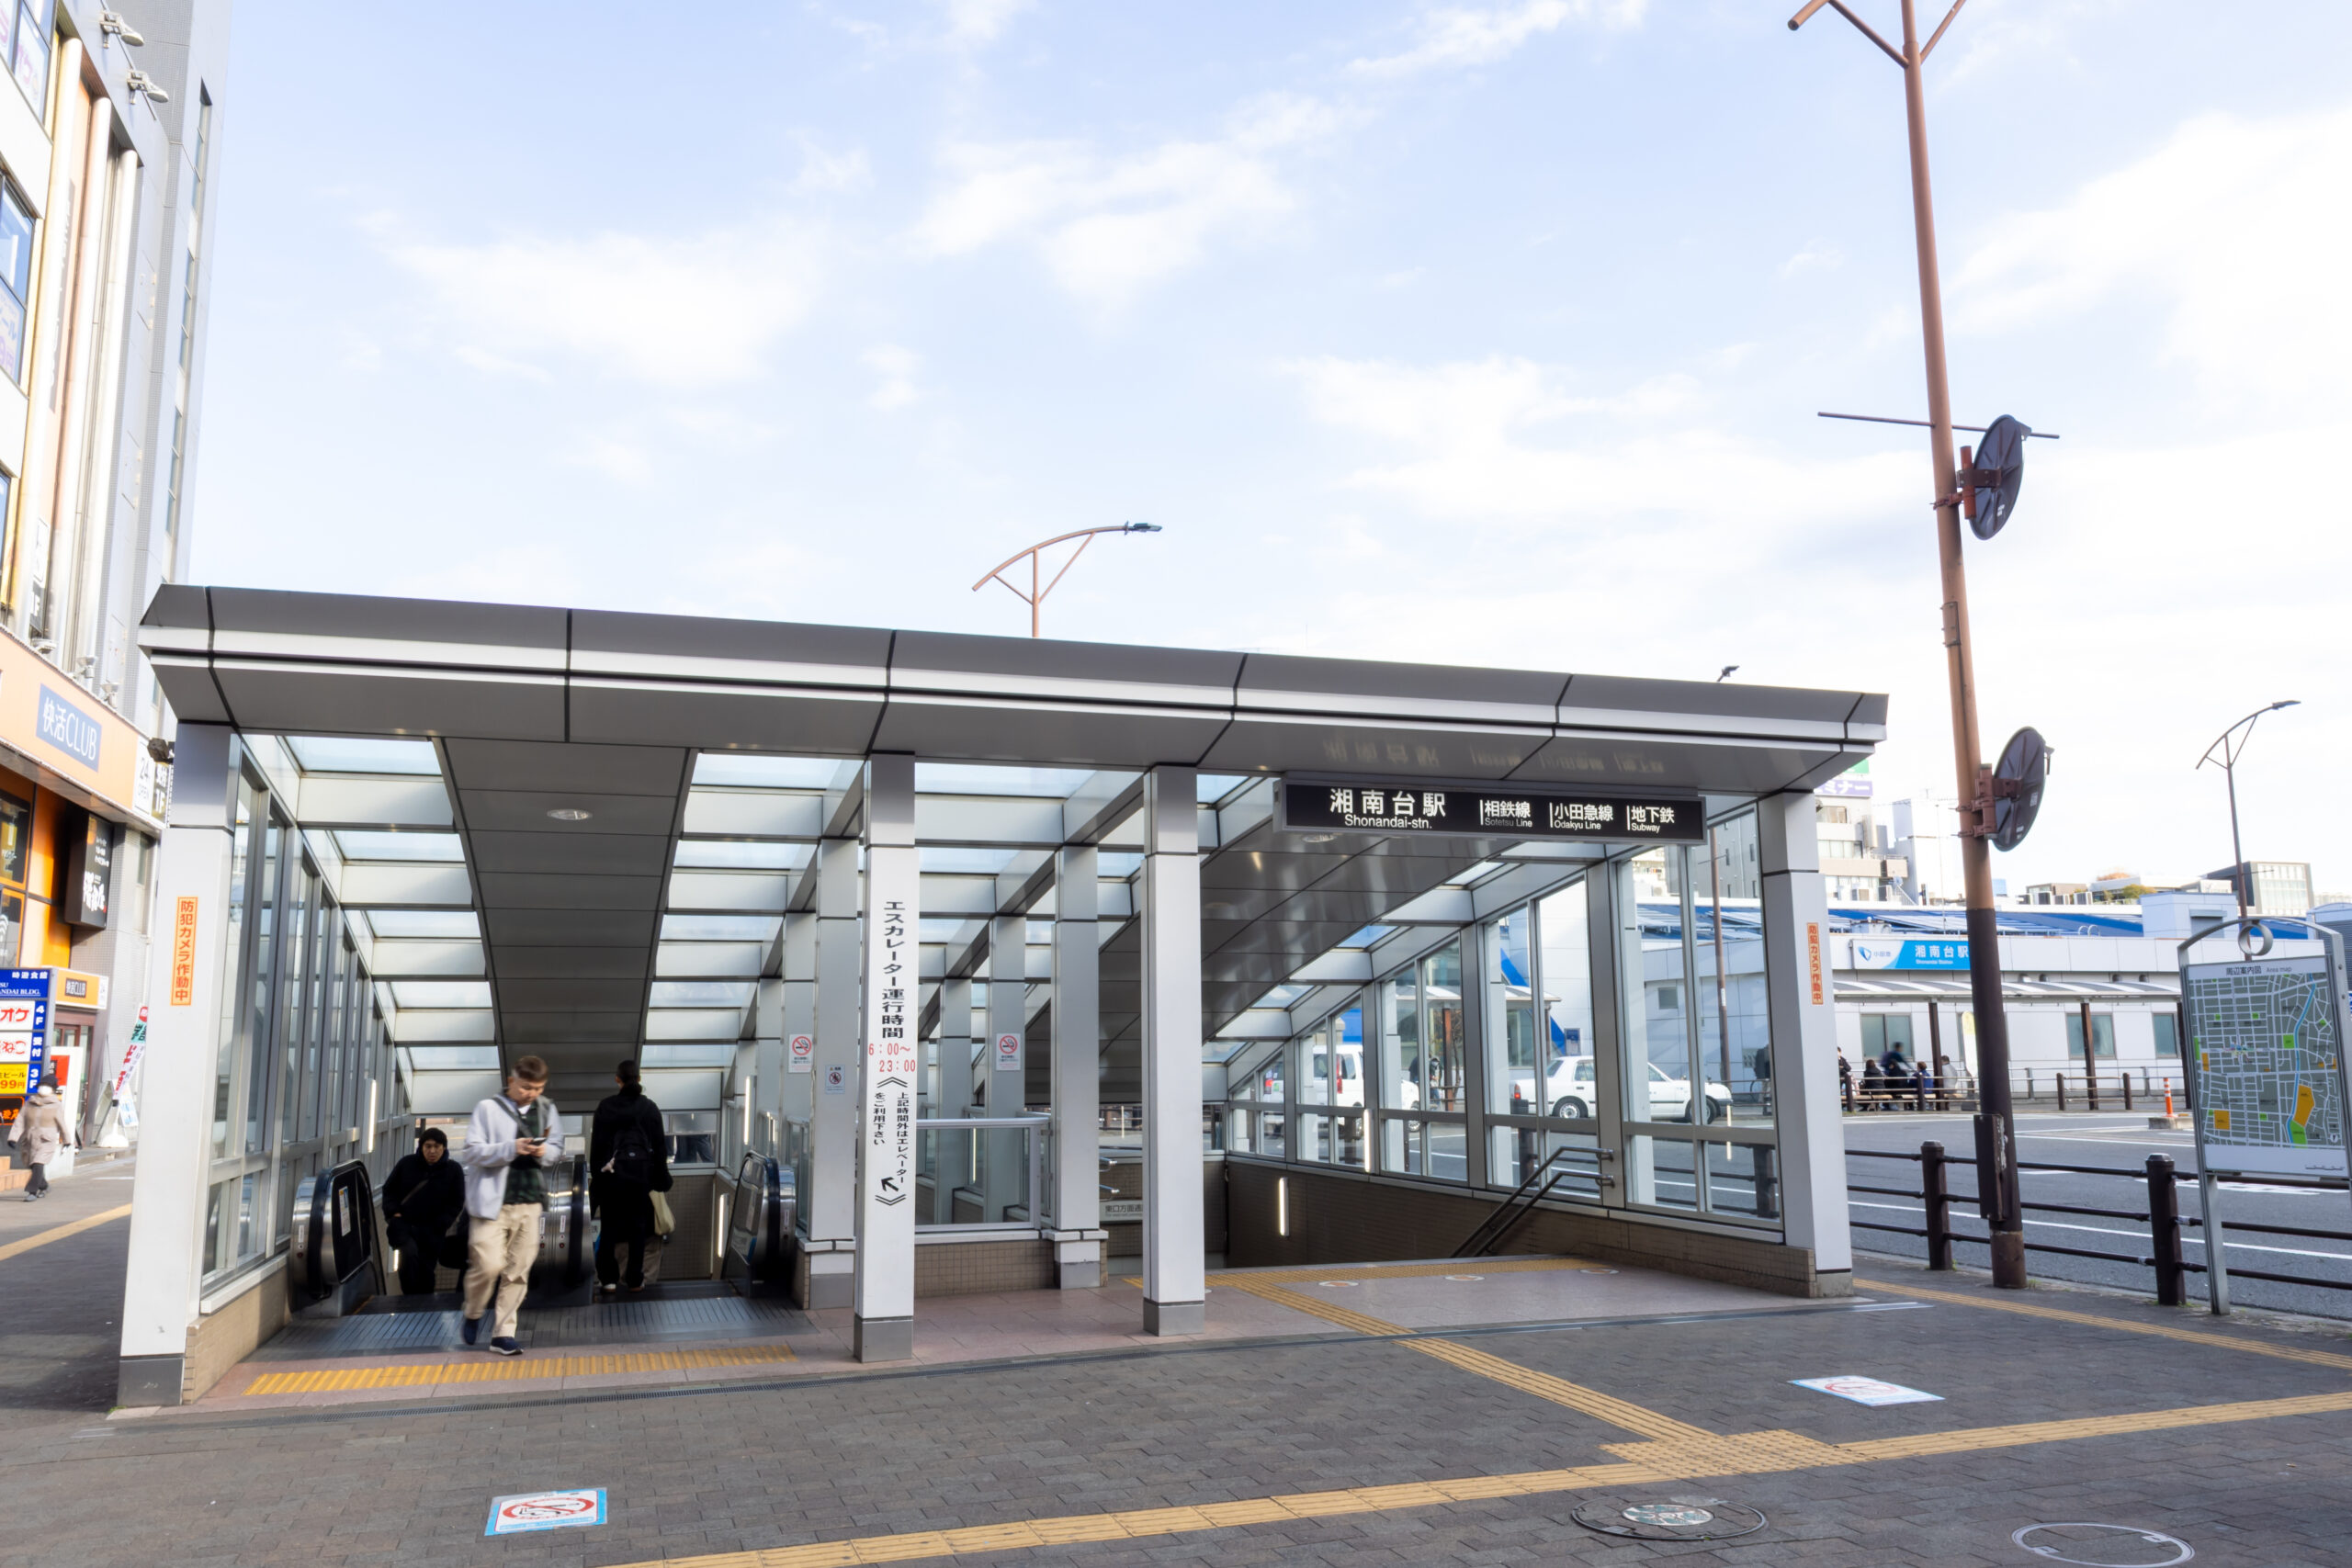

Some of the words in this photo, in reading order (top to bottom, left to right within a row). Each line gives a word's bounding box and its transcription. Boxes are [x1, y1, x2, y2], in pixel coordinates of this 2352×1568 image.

[43, 696, 96, 761] 快活CLUB
[1330, 788, 1446, 818] 湘南台駅
[1485, 800, 1531, 818] 相鉄線
[1344, 814, 1432, 829] Shonandai-stn.
[1555, 803, 1613, 822] 小田急線
[1632, 806, 1675, 824] 地下鉄
[1485, 818, 1514, 827] Sotetsu
[1516, 818, 1532, 828] Line
[1555, 819, 1583, 830] Odakyu
[1585, 821, 1601, 829] Line
[1632, 823, 1660, 834] Subway
[175, 900, 194, 1001] 防犯カメラ作動中
[1915, 944, 1970, 958] 湘南台駅
[882, 901, 905, 1039] エスカレーター運行時間
[1809, 925, 1822, 1001] 防犯カメラ作動中
[2226, 965, 2262, 976] 周辺案内図
[0, 1008, 29, 1022] オケ
[0, 1040, 27, 1055] ねこ
[28, 1068, 39, 1089] 3F
[873, 1092, 886, 1145] をご利用下さい
[897, 1091, 910, 1183] 上記時間外はエレベーター
